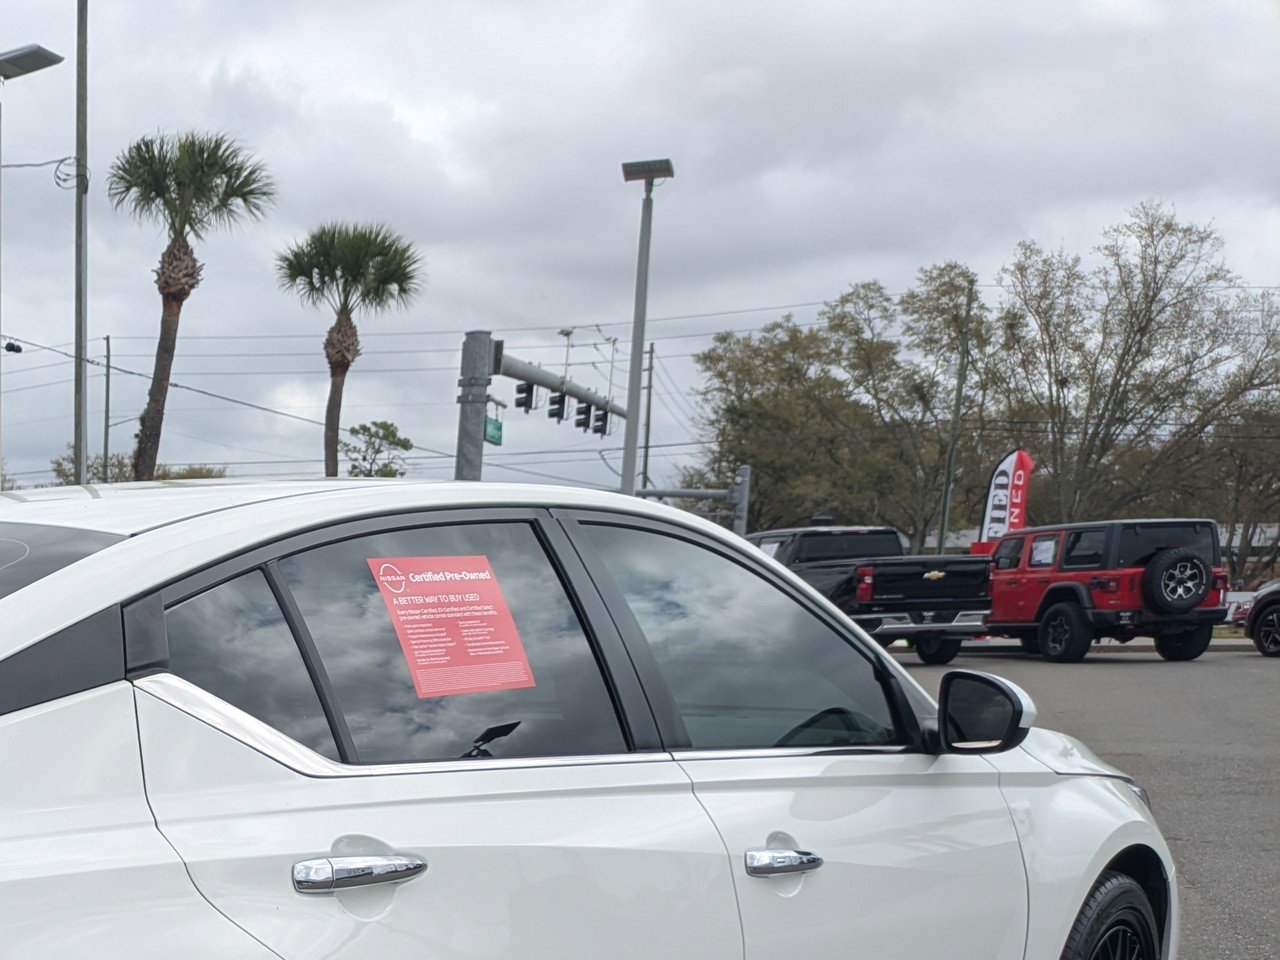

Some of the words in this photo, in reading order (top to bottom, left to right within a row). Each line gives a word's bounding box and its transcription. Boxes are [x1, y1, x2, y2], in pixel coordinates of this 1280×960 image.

[409, 571, 445, 582] Certified
[445, 570, 491, 581] Pre-Owned
[393, 597, 399, 605] A
[399, 595, 424, 605] BETTER
[424, 595, 438, 603] WAY
[438, 594, 449, 603] TO
[449, 594, 462, 602] BUY
[462, 593, 480, 602] USED
